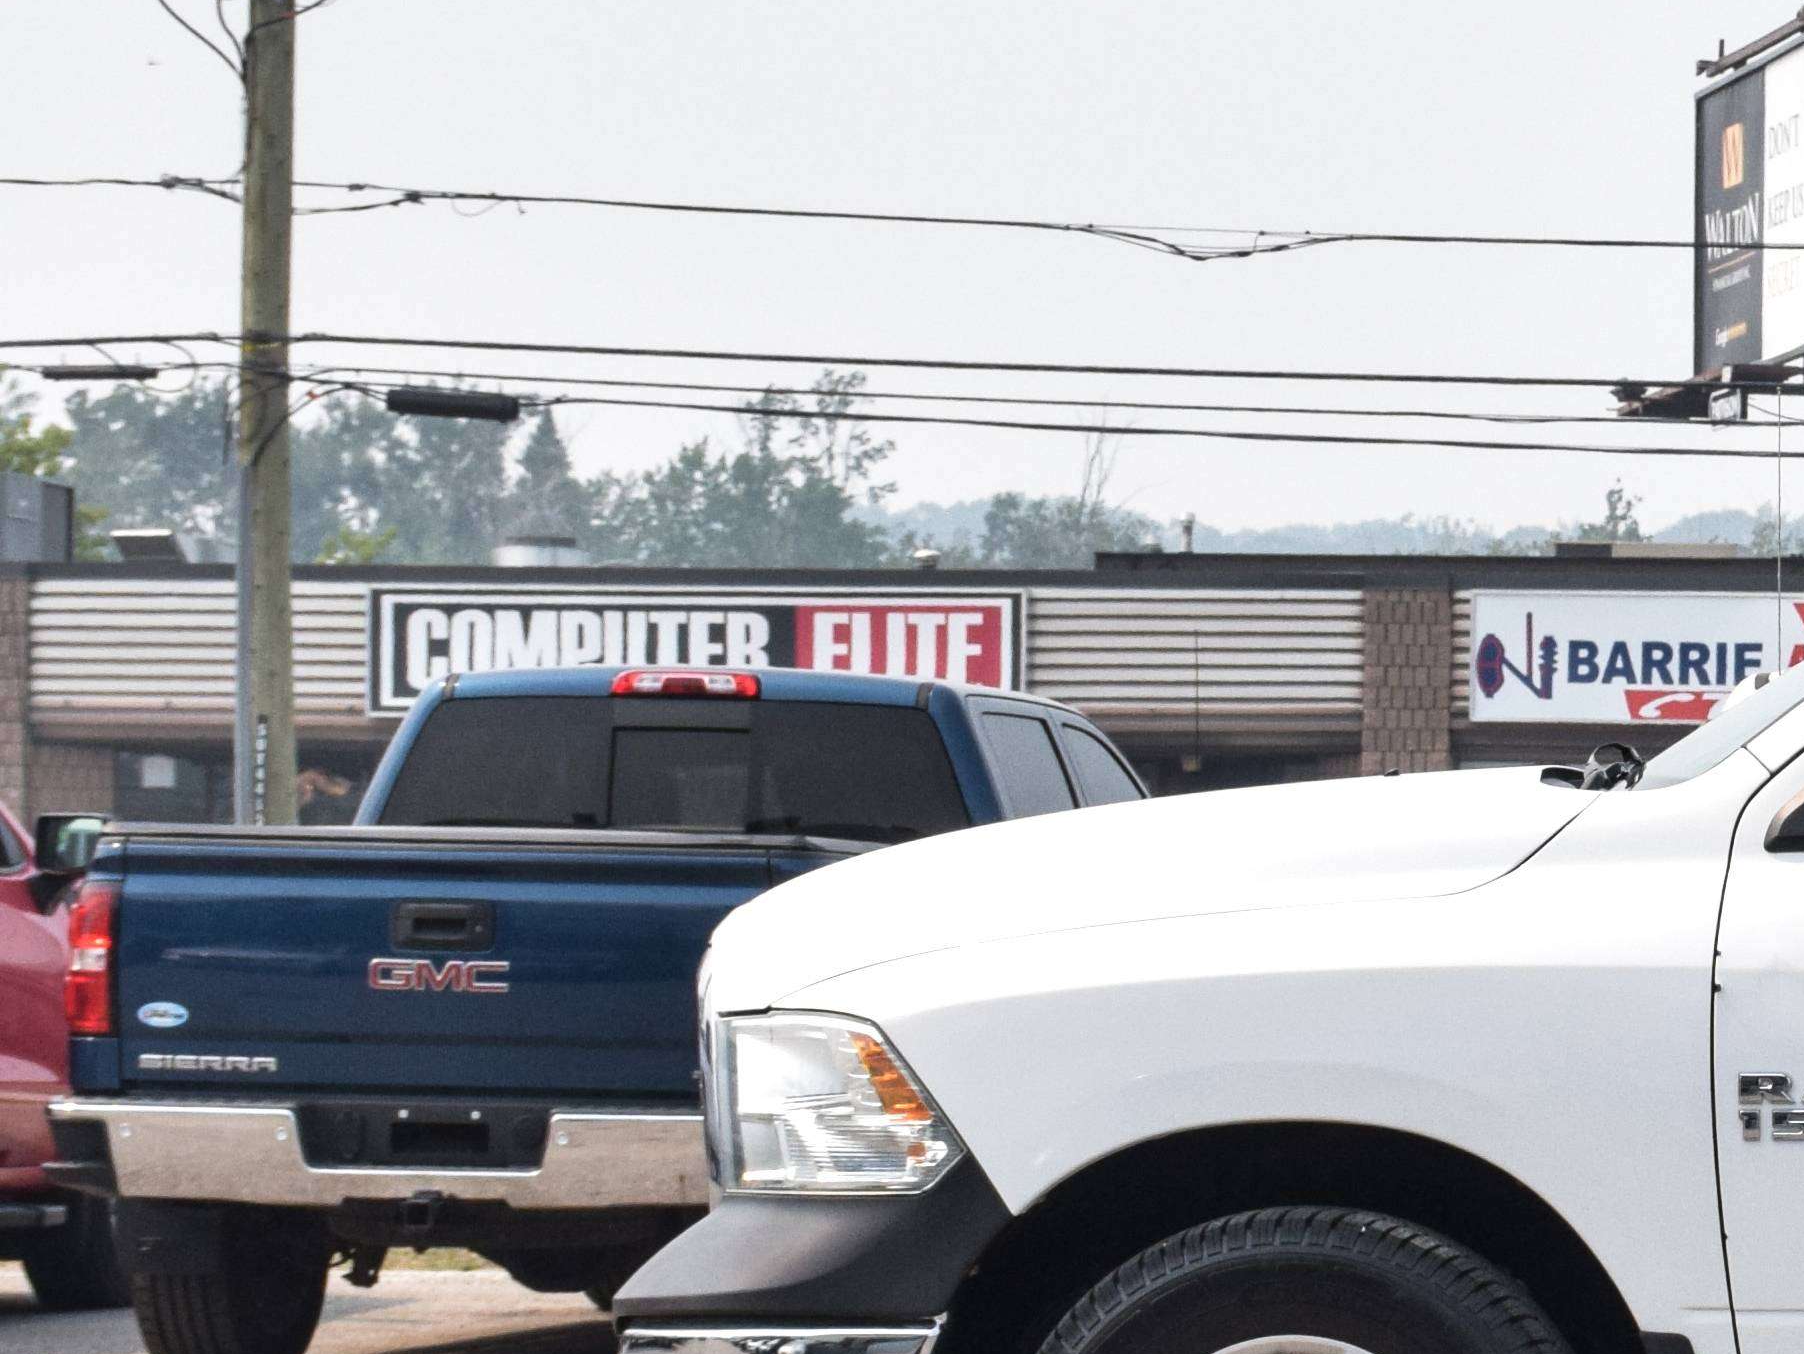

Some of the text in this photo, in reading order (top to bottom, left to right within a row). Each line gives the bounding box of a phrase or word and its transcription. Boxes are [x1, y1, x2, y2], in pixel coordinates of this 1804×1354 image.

[406, 606, 986, 690] COMPUTER ELITE
[1567, 639, 1764, 686] BARRIE
[368, 958, 510, 993] GMC
[138, 1053, 278, 1073] SIERRA
